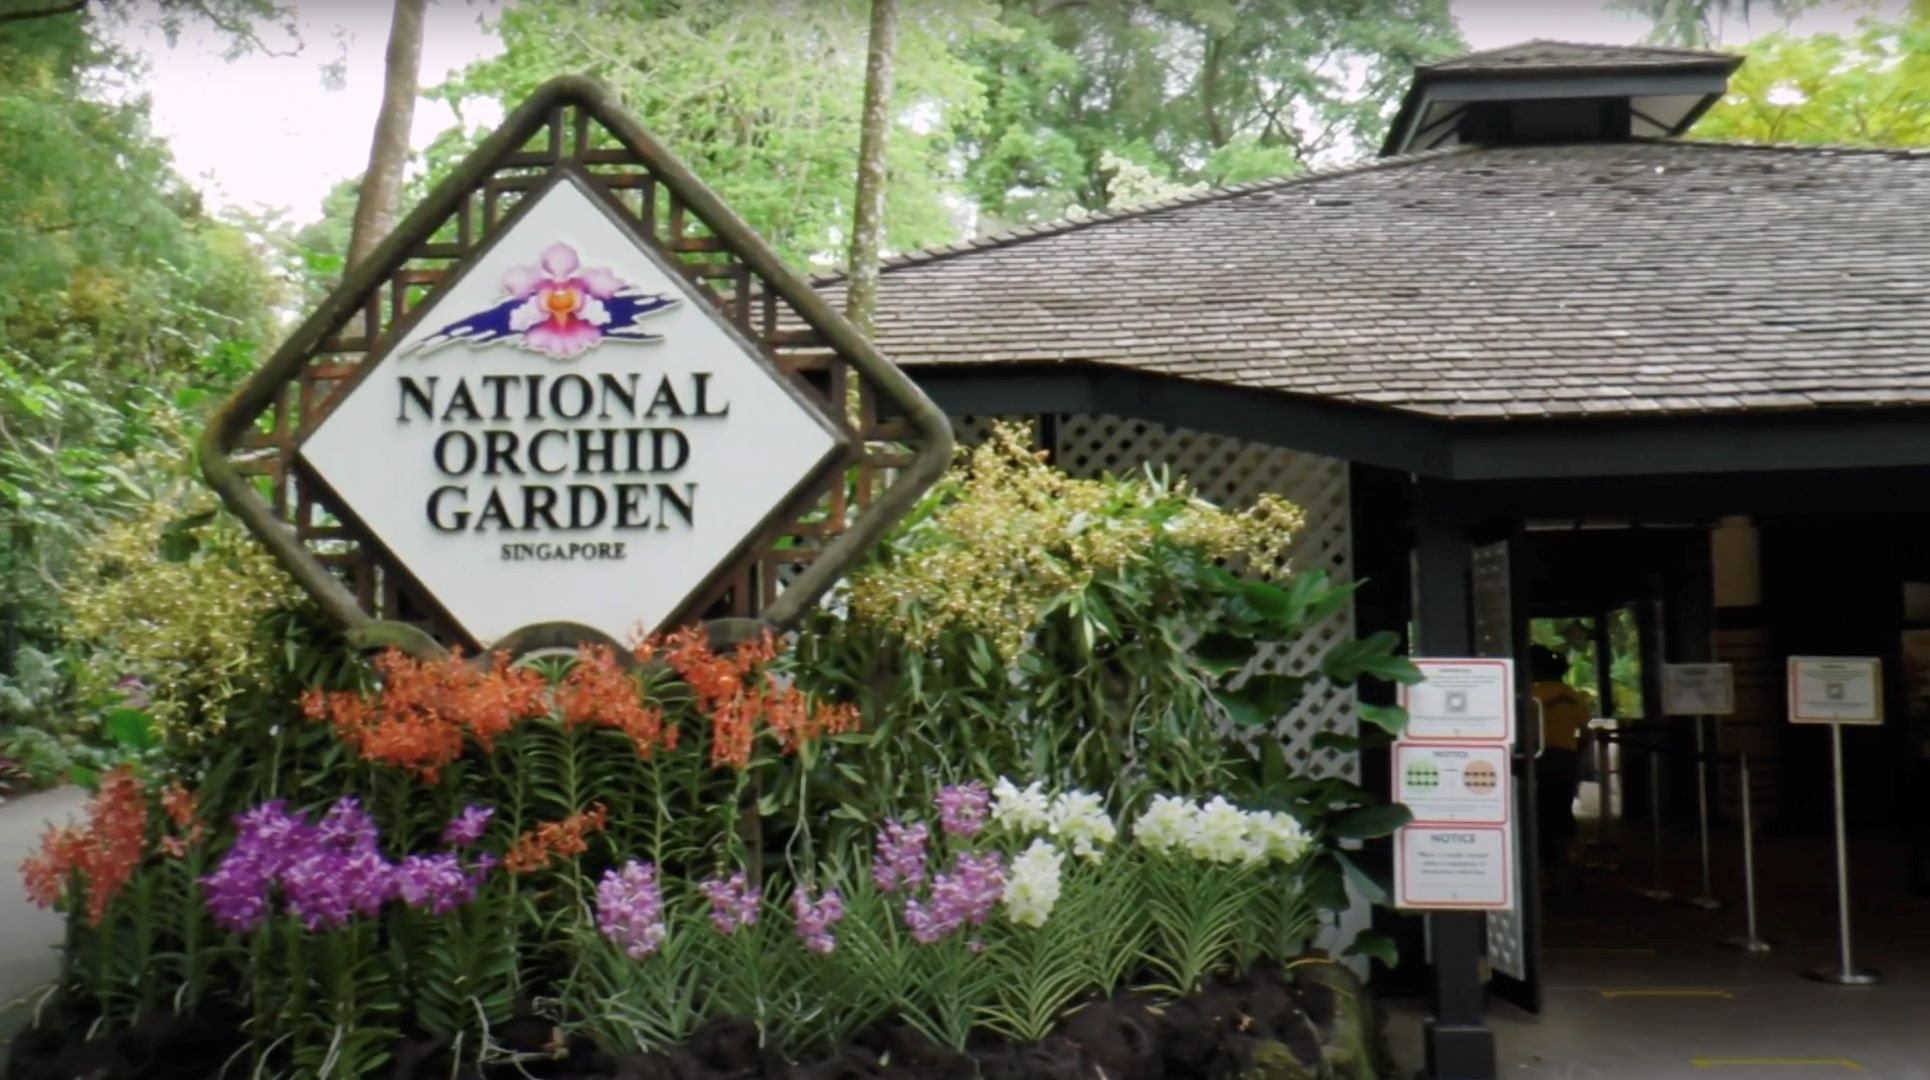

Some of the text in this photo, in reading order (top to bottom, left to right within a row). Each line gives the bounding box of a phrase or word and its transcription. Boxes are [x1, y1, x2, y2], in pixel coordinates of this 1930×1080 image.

[396, 373, 730, 422] NATIONAL
[433, 428, 690, 476] ORCHID
[426, 482, 698, 533] GARDEN
[501, 543, 626, 561] SINGAPORE
[1430, 833, 1476, 844] NOTICE
